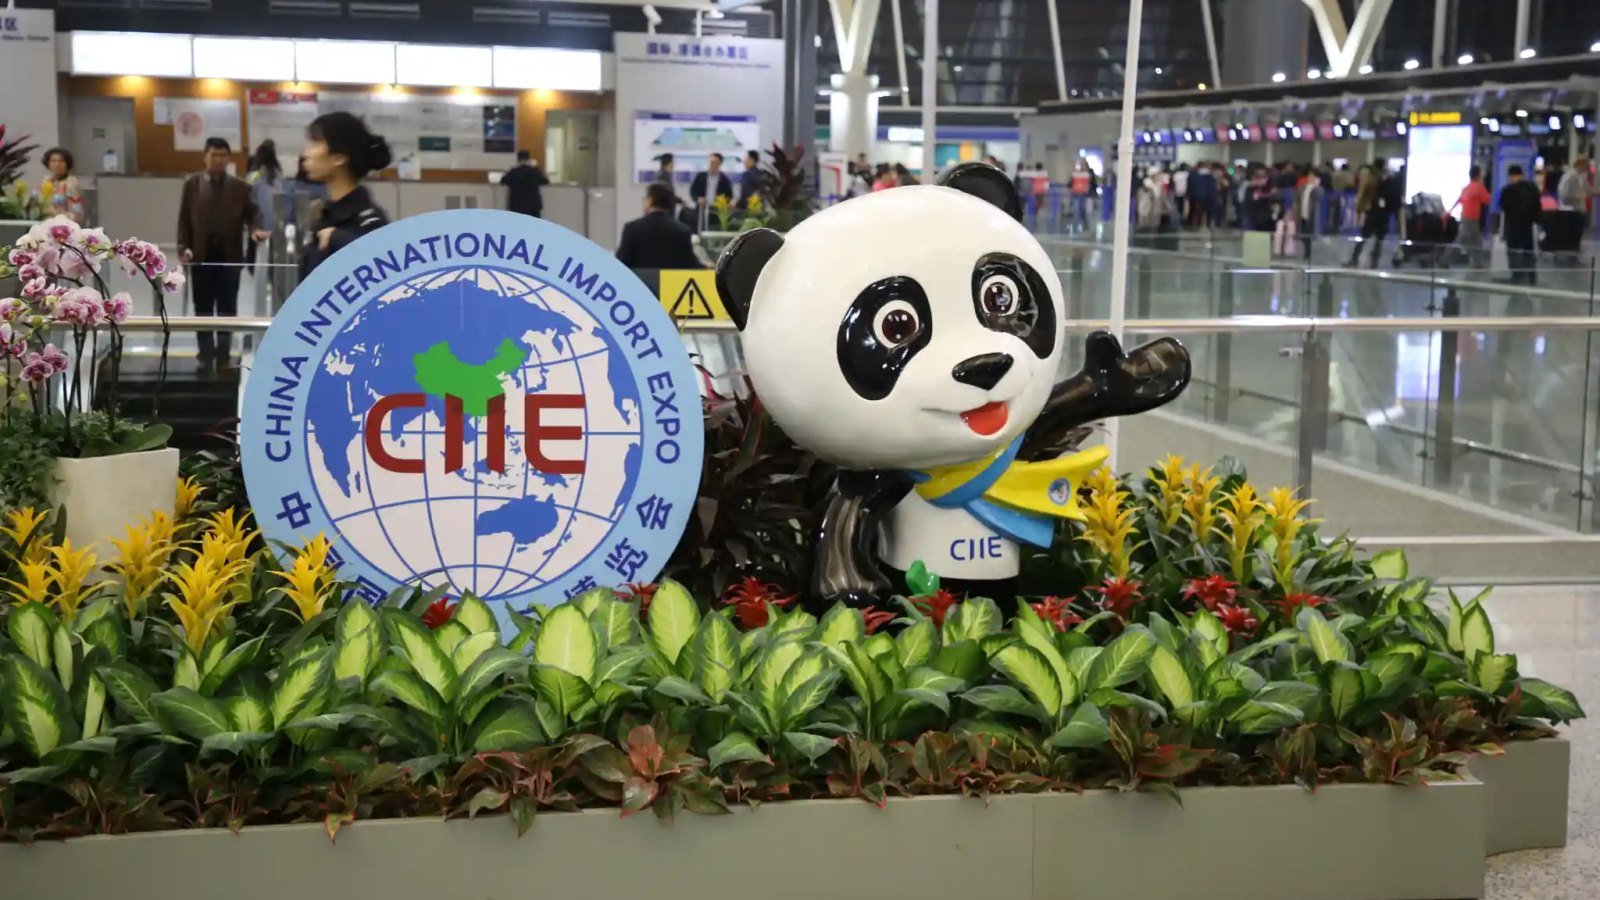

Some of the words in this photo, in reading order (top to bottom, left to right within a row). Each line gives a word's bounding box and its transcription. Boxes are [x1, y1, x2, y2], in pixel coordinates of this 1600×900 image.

[265, 356, 308, 463] CHINA
[294, 232, 549, 348] INTERNATIONAL
[558, 256, 663, 360] IMPORT
[646, 370, 682, 465] EXPO
[364, 393, 586, 474] CIIE
[949, 535, 1003, 560] CIIE
